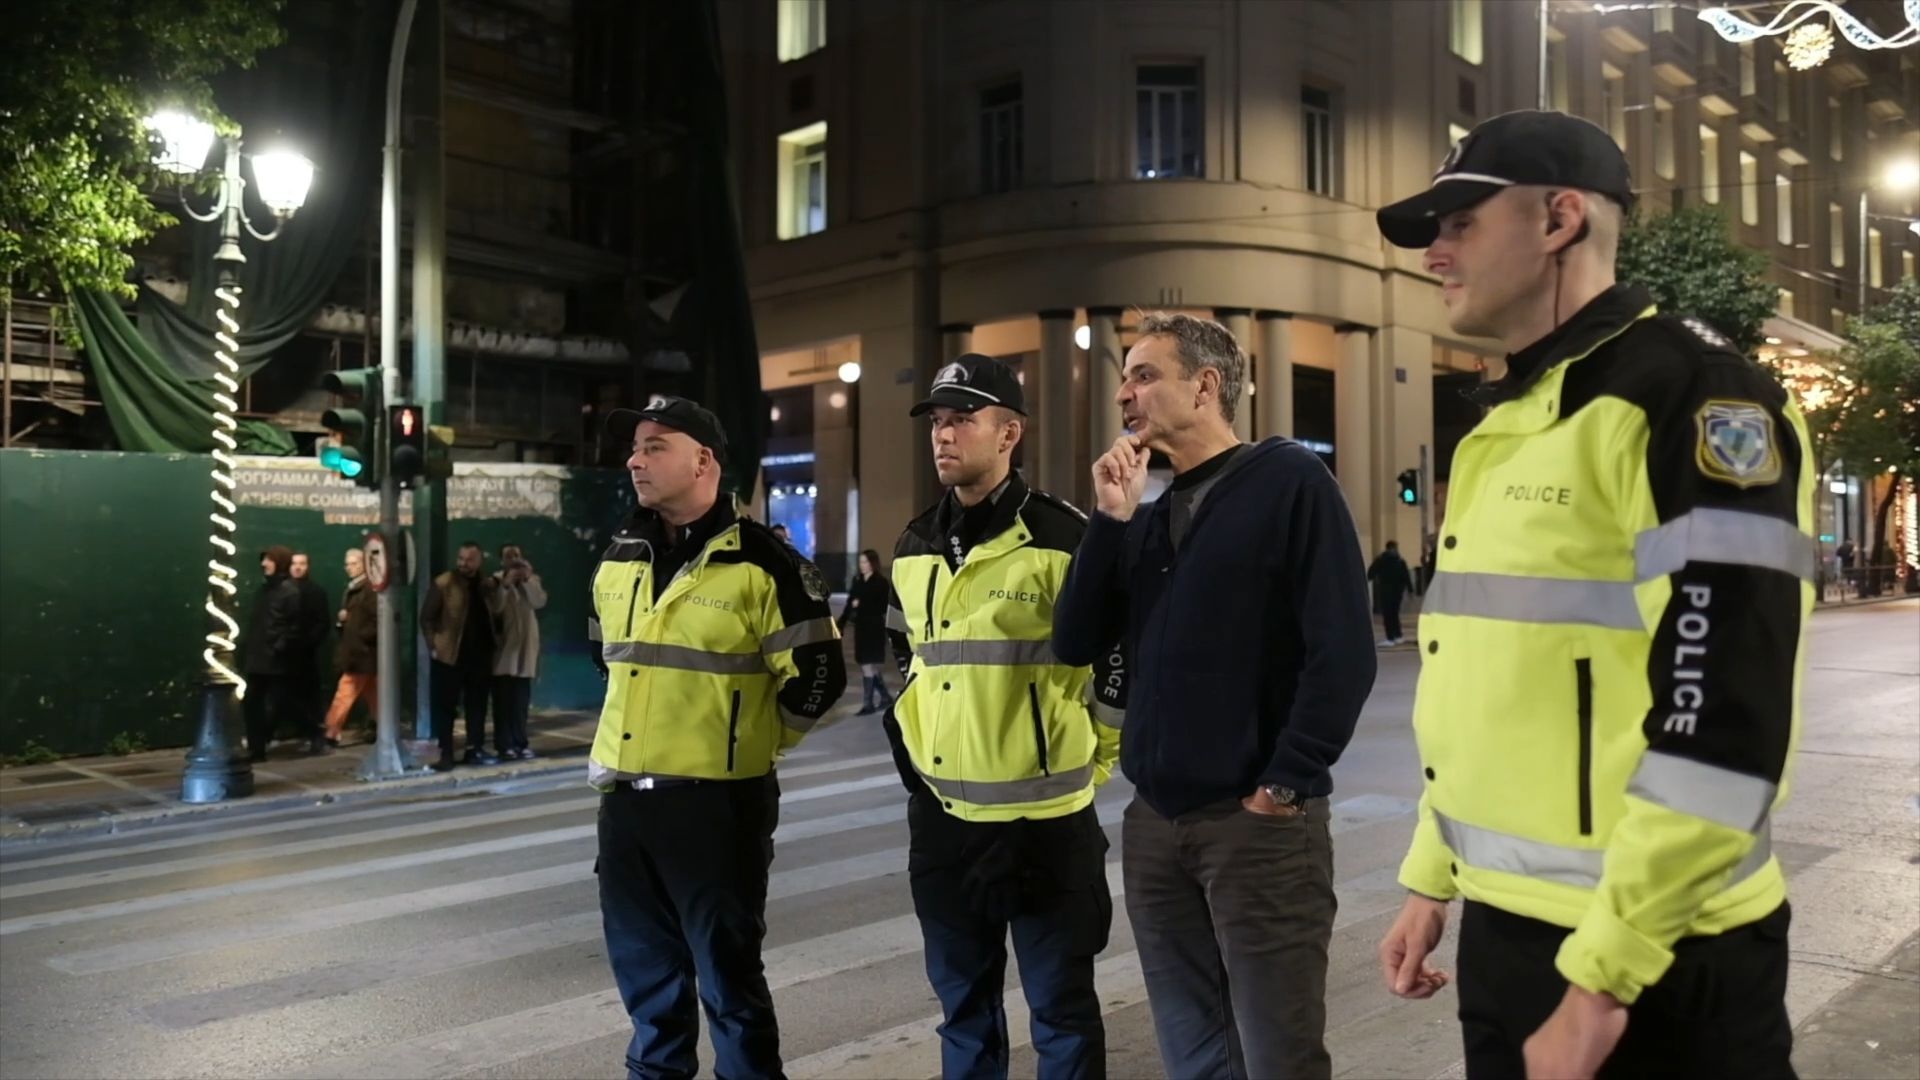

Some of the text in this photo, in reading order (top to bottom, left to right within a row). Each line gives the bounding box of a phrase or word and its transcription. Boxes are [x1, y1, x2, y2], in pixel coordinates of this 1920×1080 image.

[231, 470, 319, 487] ΡΟΓΡΑΜΜΑ
[239, 491, 304, 507] ATHENS
[1504, 485, 1571, 506] POLICE
[684, 594, 732, 611] POLICE
[988, 589, 1039, 603] POLICE
[1663, 584, 1711, 735] POLICE
[803, 653, 828, 713] POLICE
